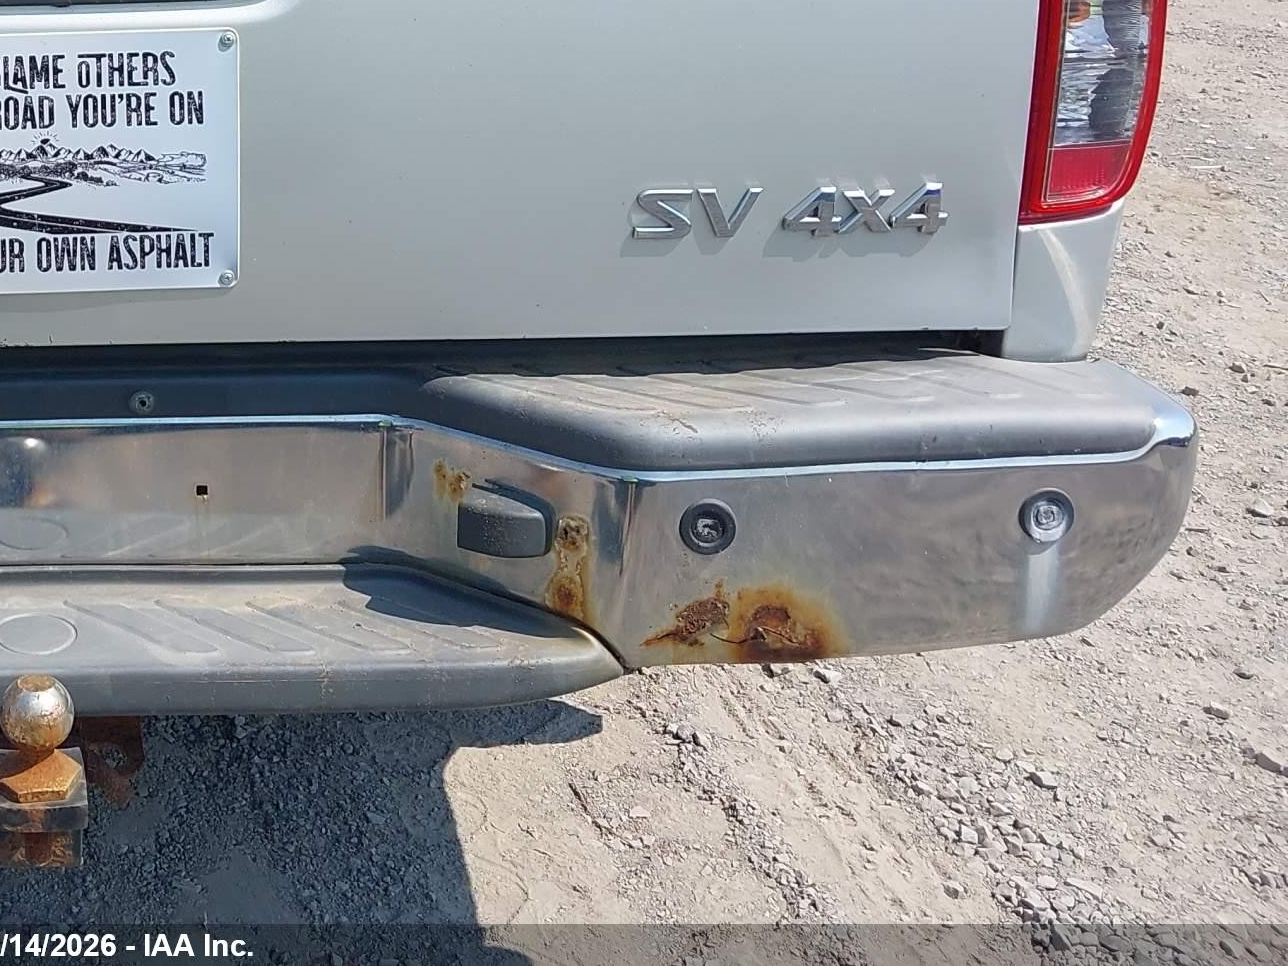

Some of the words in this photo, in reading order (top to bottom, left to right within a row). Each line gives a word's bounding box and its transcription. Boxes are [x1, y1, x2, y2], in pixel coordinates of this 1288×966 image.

[78, 51, 175, 88] OTHERS
[66, 93, 158, 128] YOU'RE
[170, 91, 203, 125] ON
[632, 187, 764, 240] SV
[37, 236, 95, 272] OWN
[108, 233, 214, 270] ASPHALT
